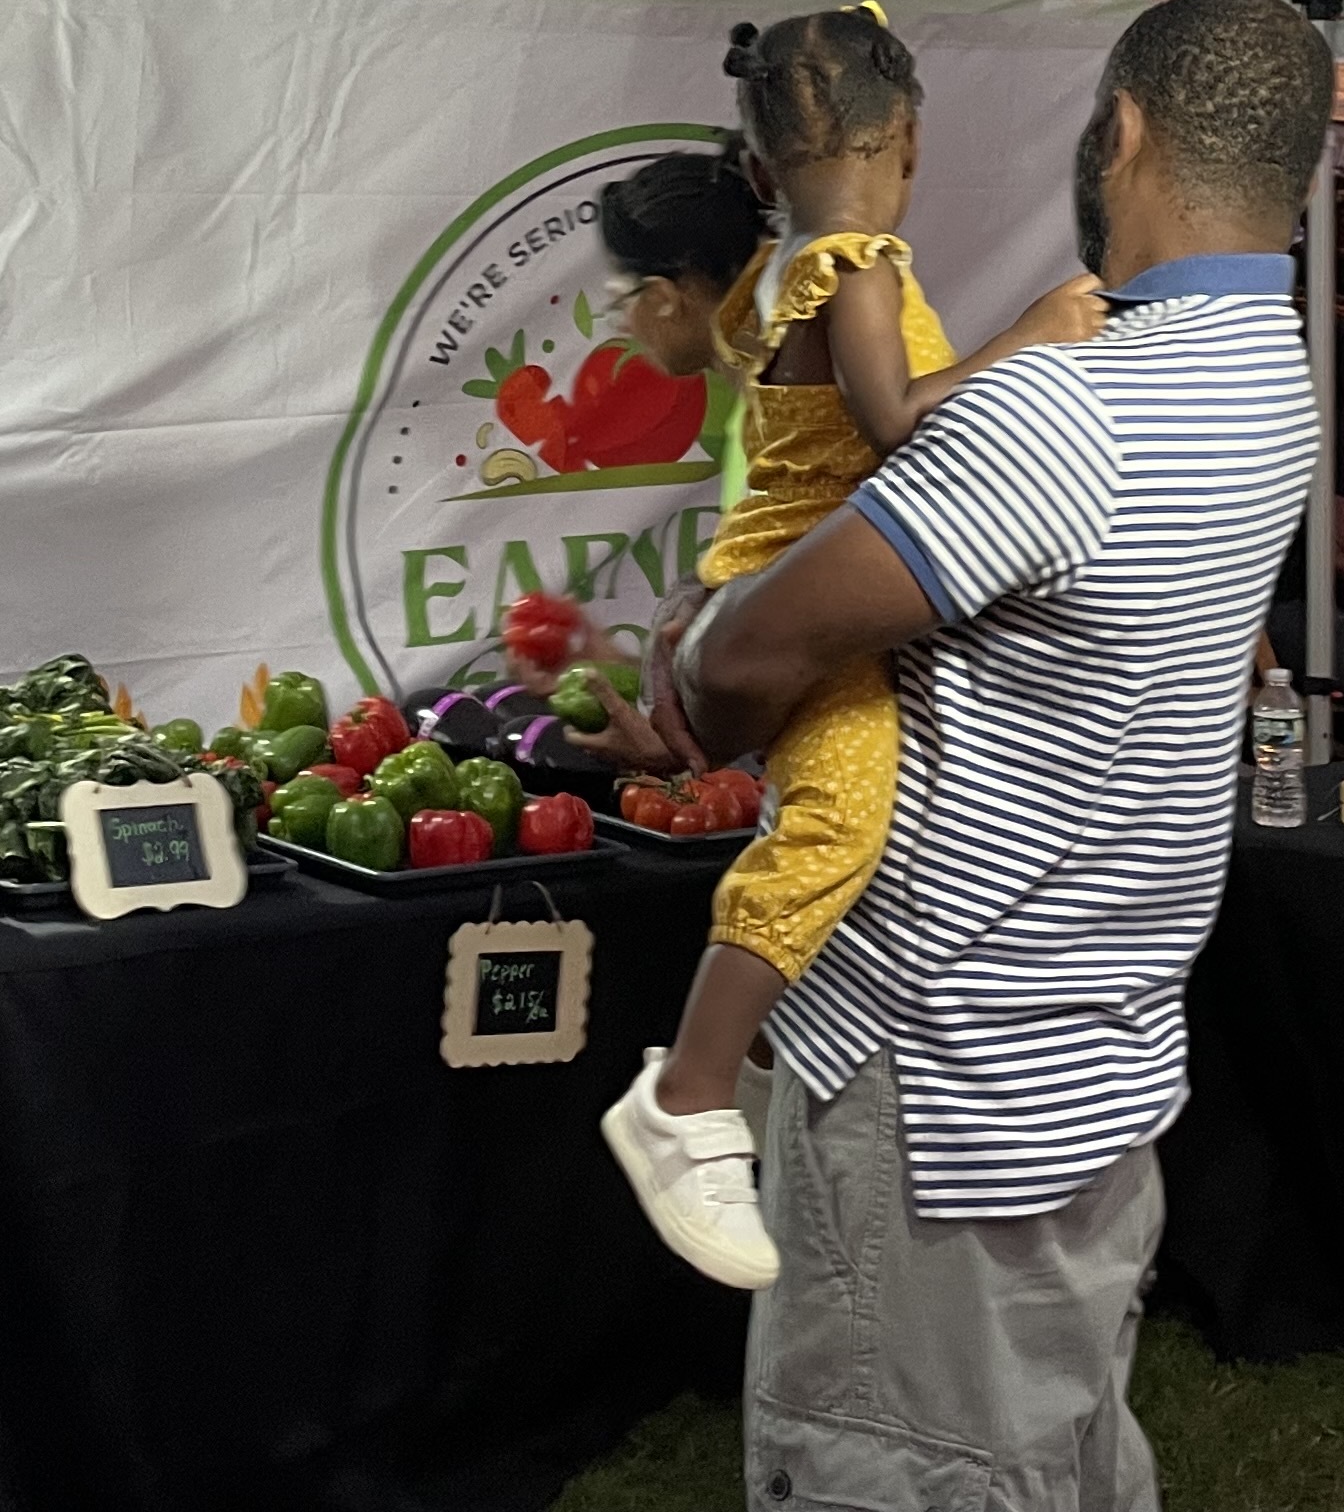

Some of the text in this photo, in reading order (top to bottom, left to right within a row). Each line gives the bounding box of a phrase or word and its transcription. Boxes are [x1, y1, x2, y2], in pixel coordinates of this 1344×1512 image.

[429, 263, 507, 365] WE'RE
[111, 814, 184, 844] Spinach
[141, 840, 190, 866] $2.99
[479, 959, 535, 985] Pepper
